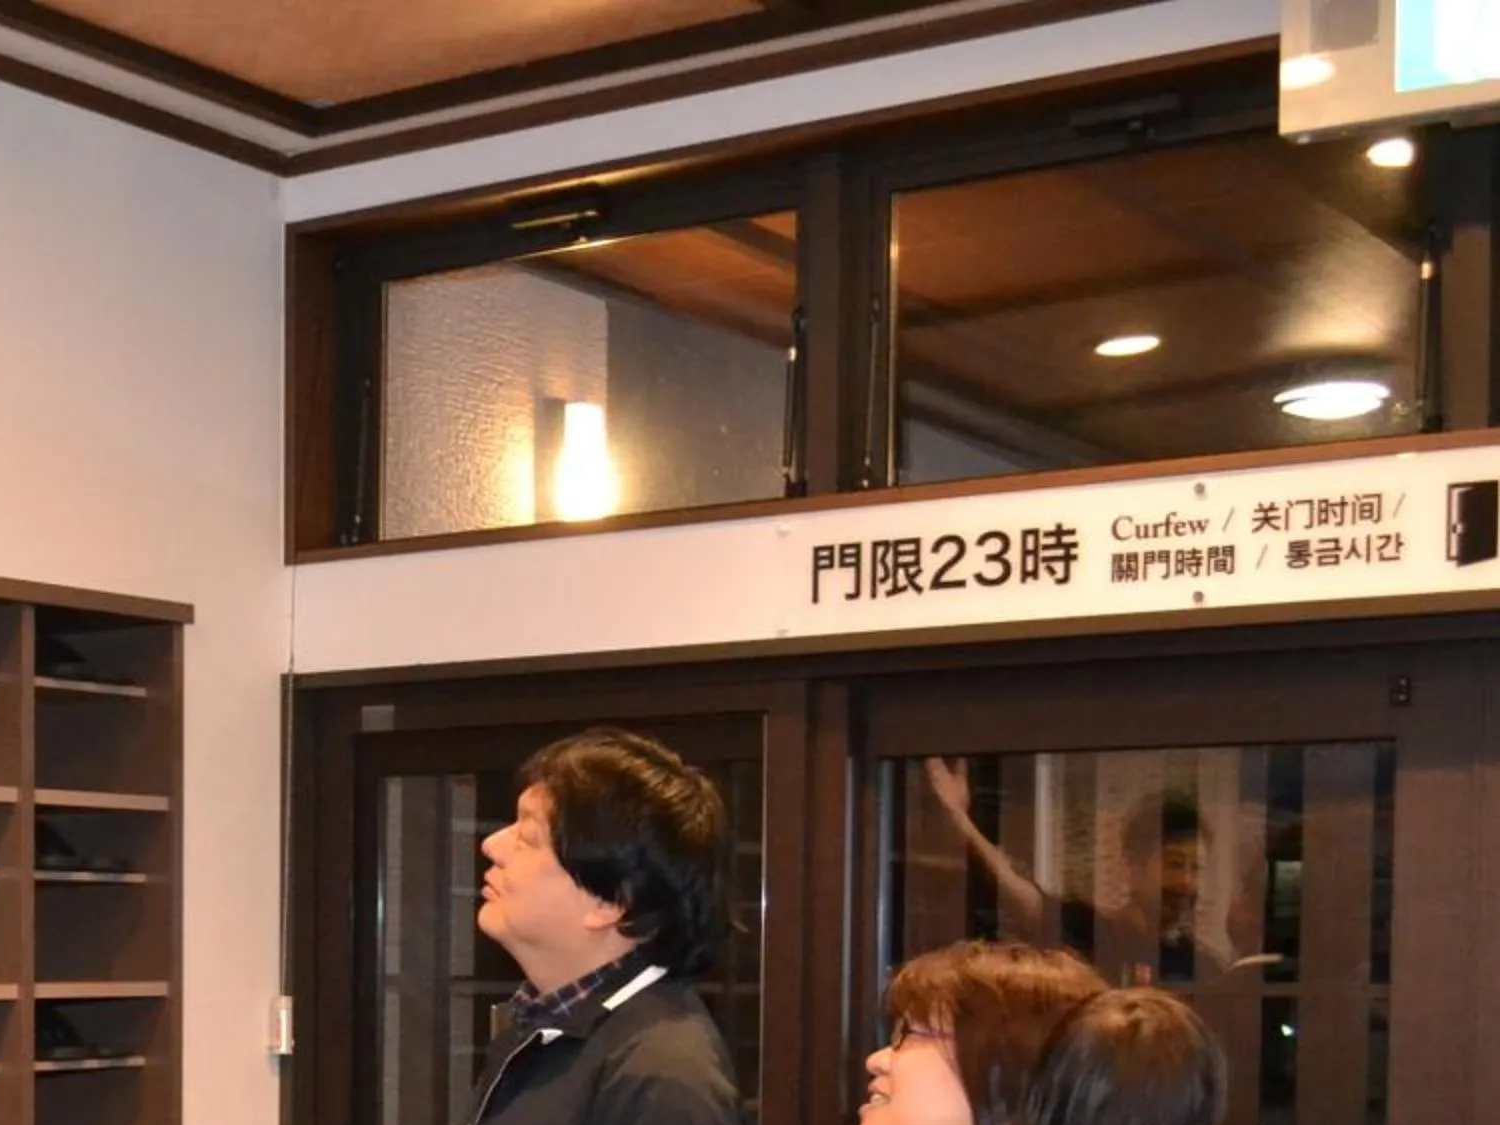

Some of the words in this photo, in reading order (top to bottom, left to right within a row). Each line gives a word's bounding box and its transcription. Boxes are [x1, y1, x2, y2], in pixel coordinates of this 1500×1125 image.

[1111, 512, 1210, 541] Curfew
[1251, 493, 1383, 534] 关门时间
[811, 523, 1079, 605] 門限23時
[1111, 545, 1236, 583] 關門時間
[1285, 532, 1404, 569] 통금시간
